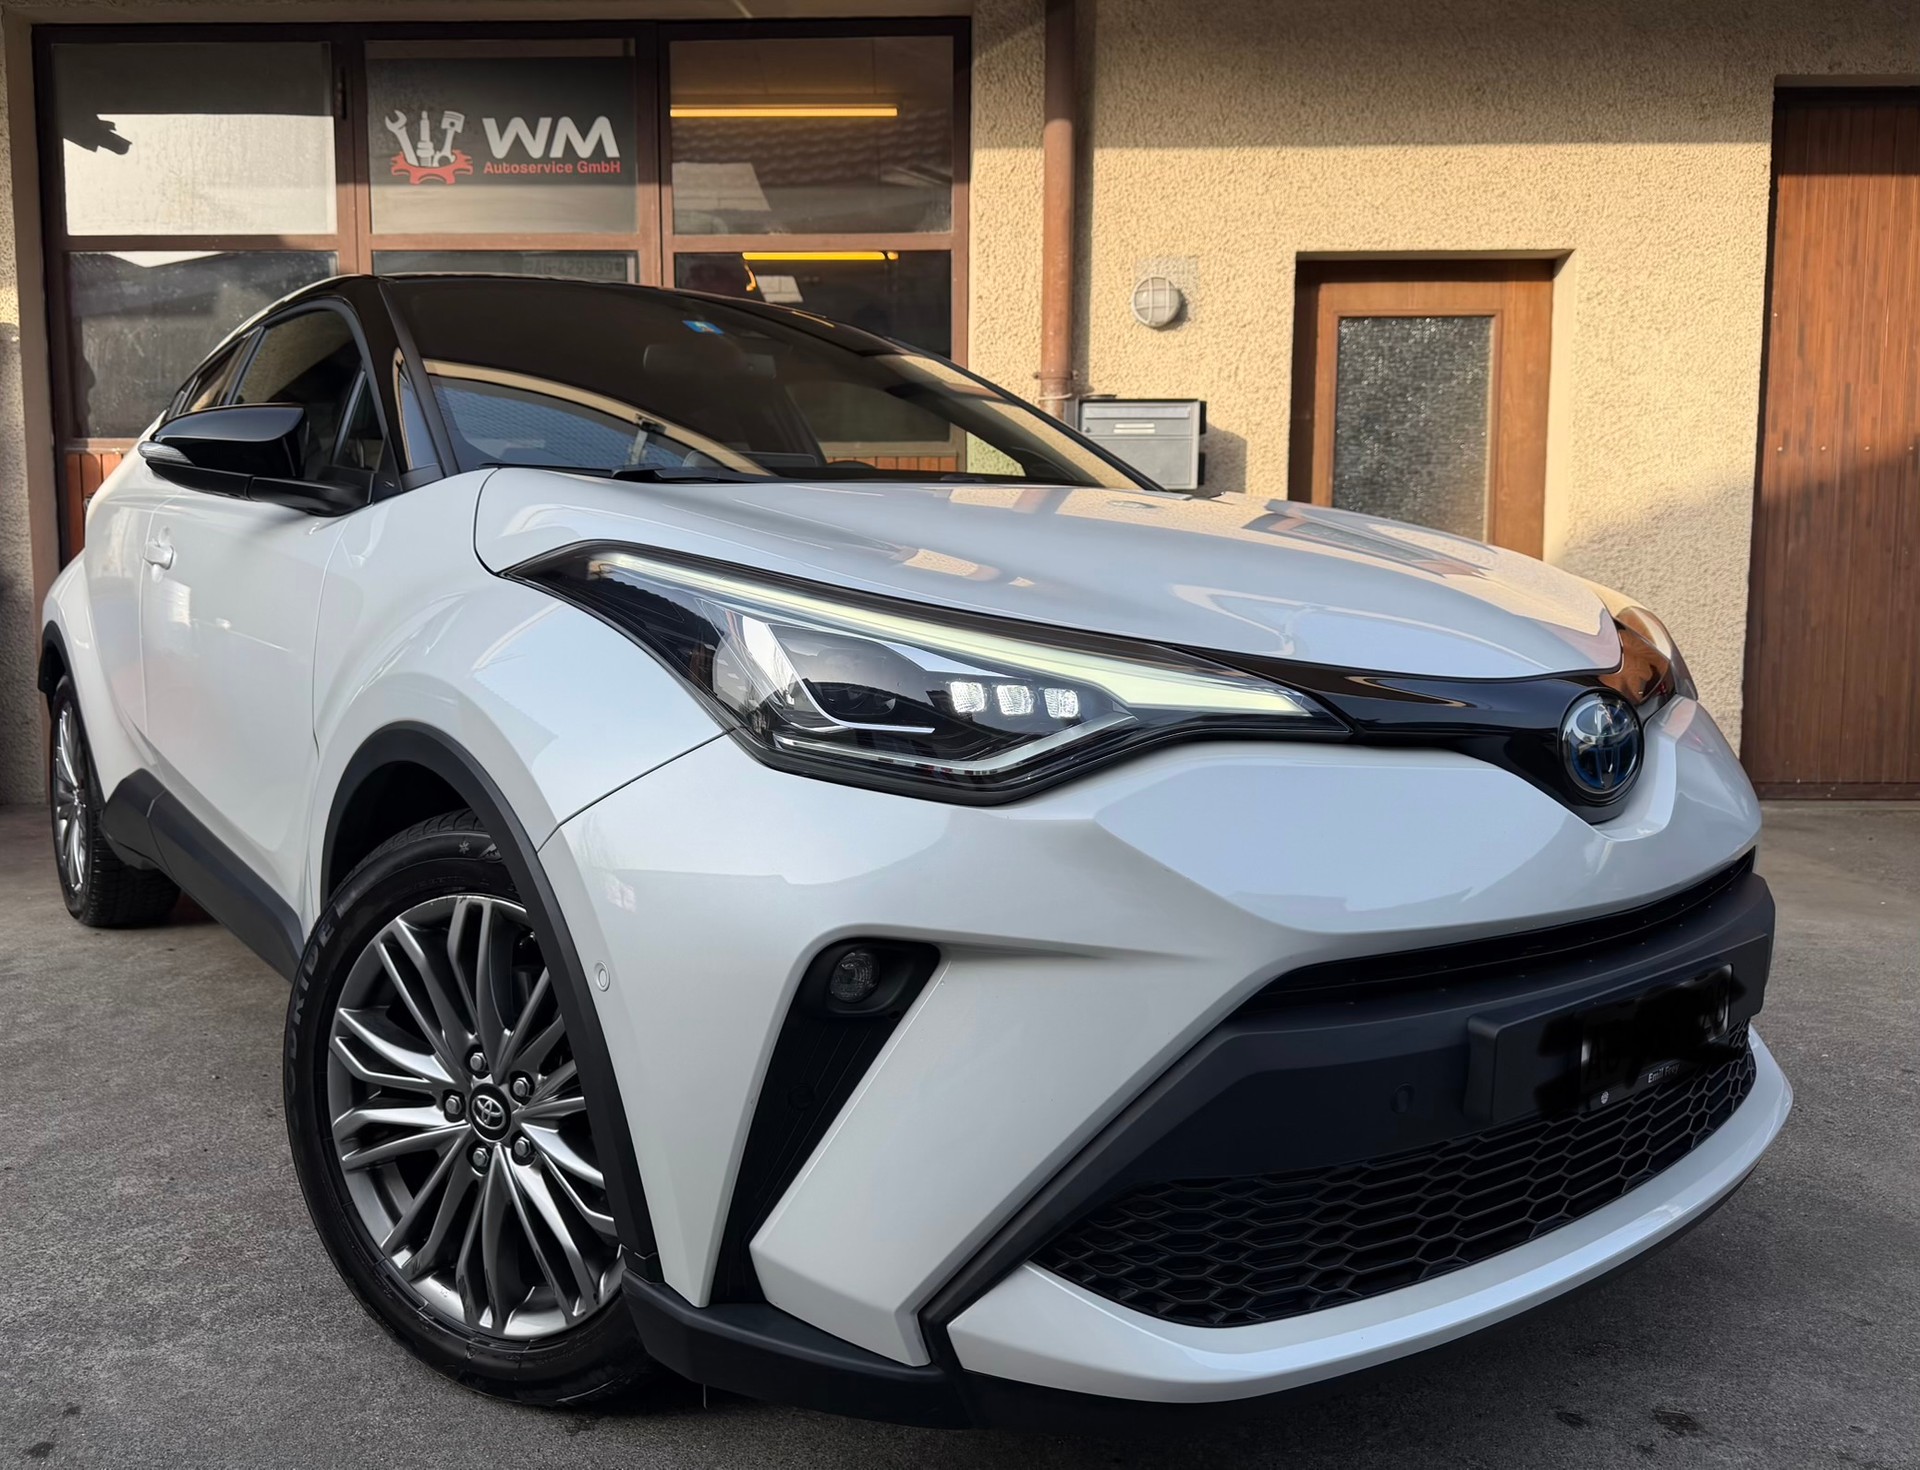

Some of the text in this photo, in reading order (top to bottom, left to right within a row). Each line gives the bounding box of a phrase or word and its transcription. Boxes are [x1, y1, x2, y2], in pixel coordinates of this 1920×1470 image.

[482, 116, 620, 159] WM
[483, 161, 621, 174] Autoservice GmbH
